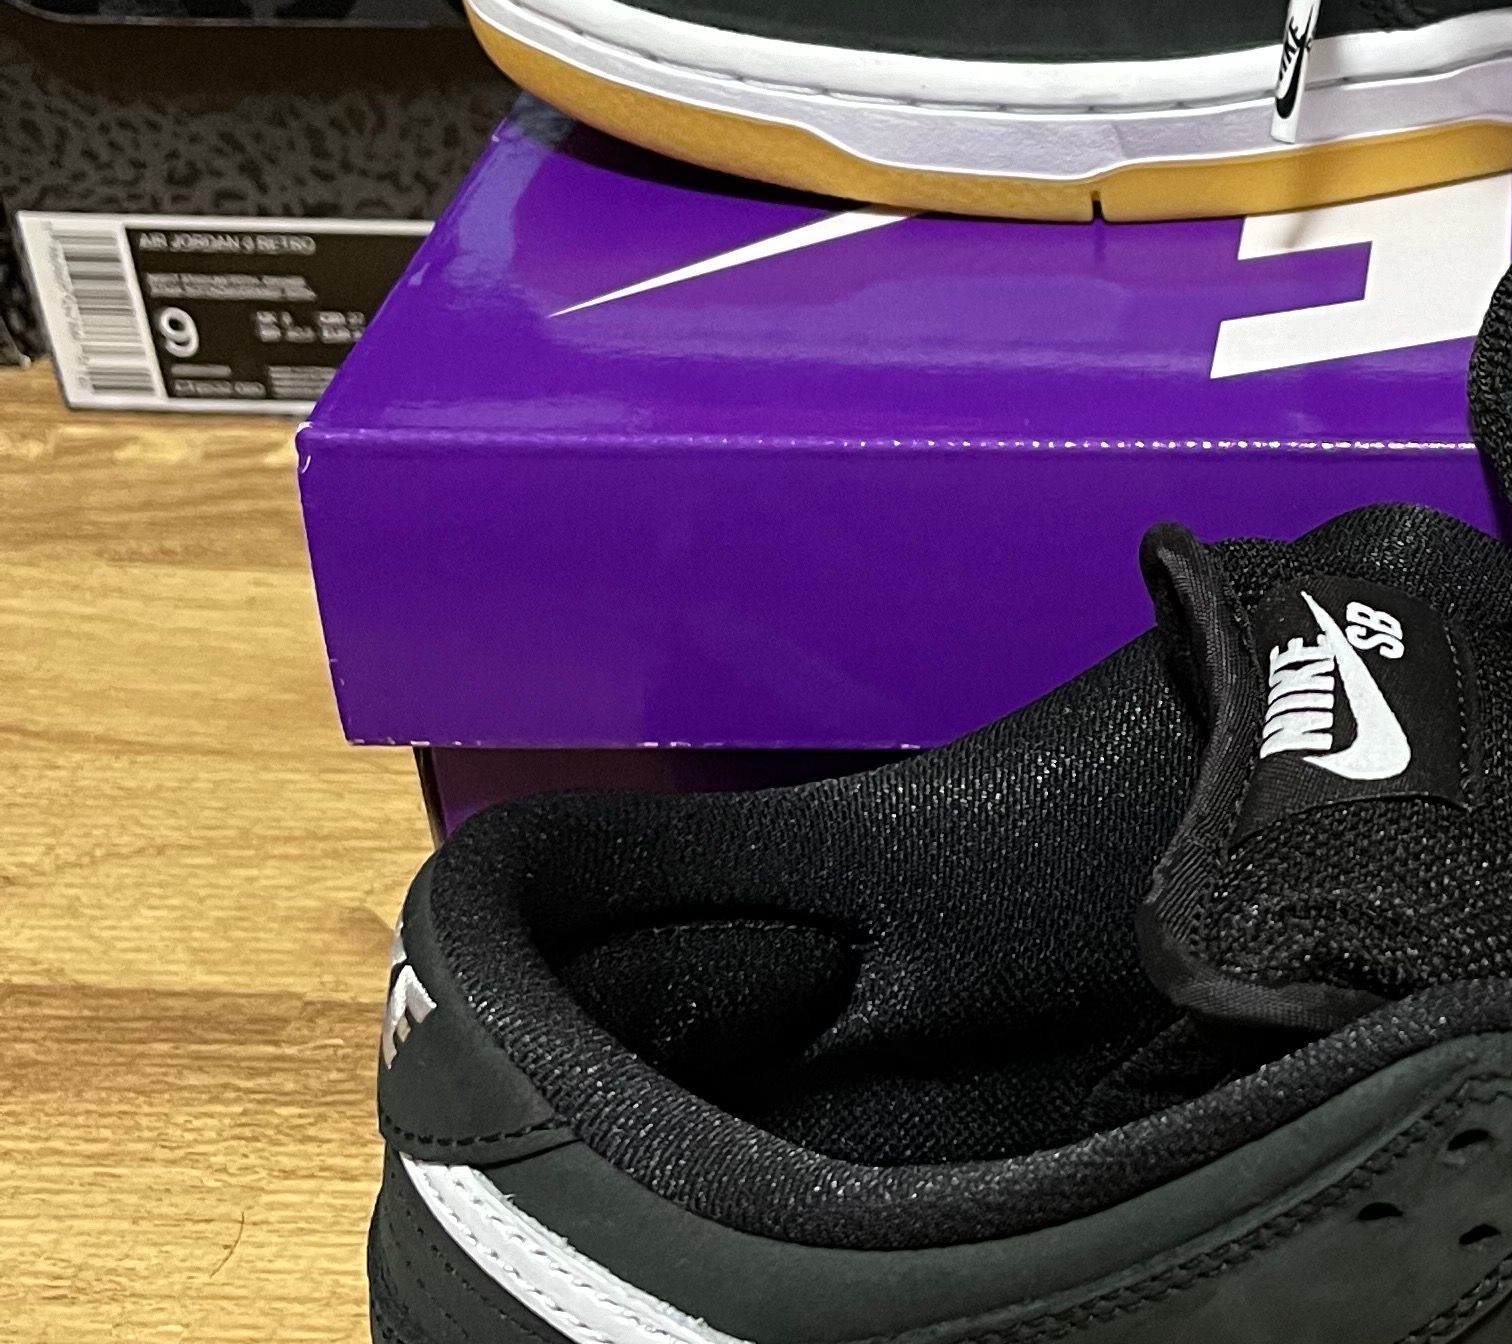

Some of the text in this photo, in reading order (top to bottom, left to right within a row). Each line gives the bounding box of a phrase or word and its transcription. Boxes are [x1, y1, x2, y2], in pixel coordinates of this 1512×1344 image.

[168, 233, 240, 254] JORDAN
[159, 306, 199, 358] 9
[1345, 602, 1404, 659] SB
[1260, 633, 1336, 758] NIKE
